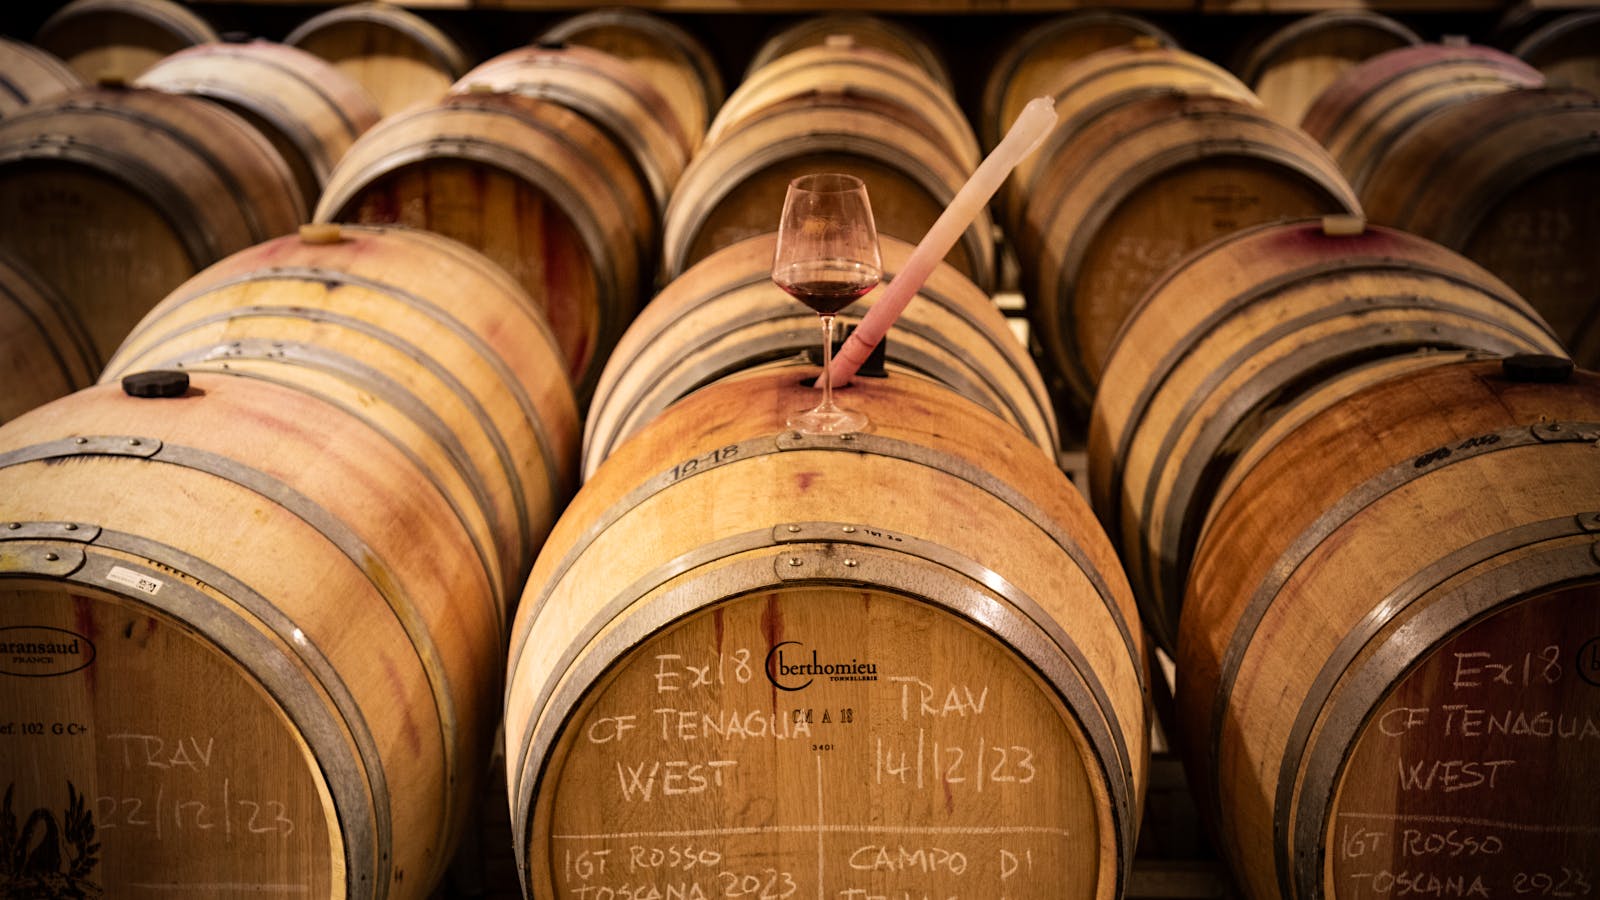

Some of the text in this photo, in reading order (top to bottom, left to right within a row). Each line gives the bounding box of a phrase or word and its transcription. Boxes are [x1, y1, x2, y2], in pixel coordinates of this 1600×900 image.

[0, 639, 80, 655] aransaud
[12, 656, 54, 664] FRANCE
[779, 649, 878, 676] berthomieu
[888, 676, 988, 721] TRAV
[0, 722, 17, 735] ef.
[22, 722, 44, 736] 102
[588, 715, 637, 743] CF
[821, 708, 833, 724] A
[1379, 707, 1430, 737] CF
[107, 734, 215, 771] TRAV
[811, 744, 835, 752] 3401
[617, 760, 739, 802] WEST
[1399, 756, 1517, 793] WEST
[1402, 828, 1503, 857] ROSSO
[630, 845, 722, 873] ROSSO
[849, 845, 1032, 882] CAMPO DI
[718, 867, 797, 900] 2023
